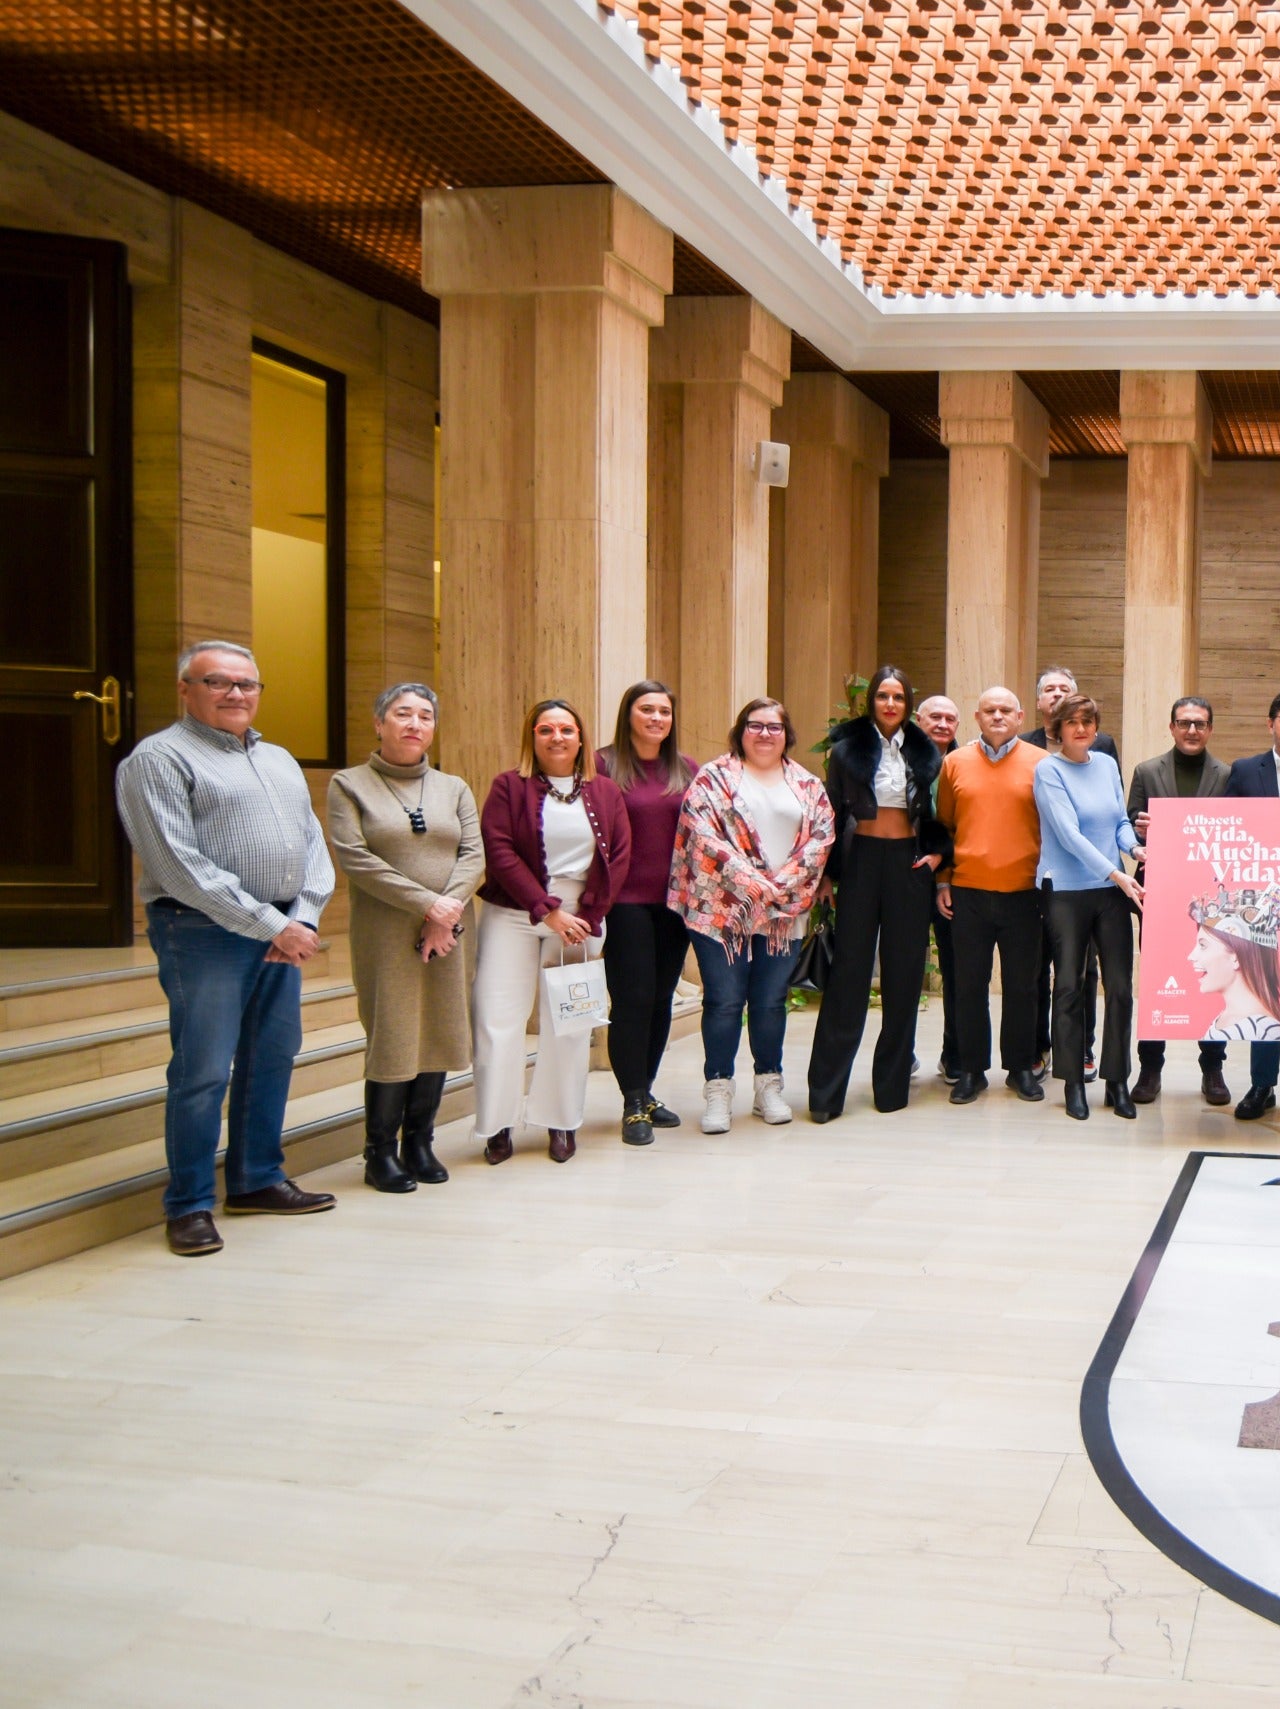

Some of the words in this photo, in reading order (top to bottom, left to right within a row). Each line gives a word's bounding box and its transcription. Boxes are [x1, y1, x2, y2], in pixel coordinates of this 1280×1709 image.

[1183, 815, 1243, 825] Albacete
[1183, 826, 1197, 834] es
[1198, 826, 1254, 845] Vida,
[560, 1000, 600, 1013] FeCom
